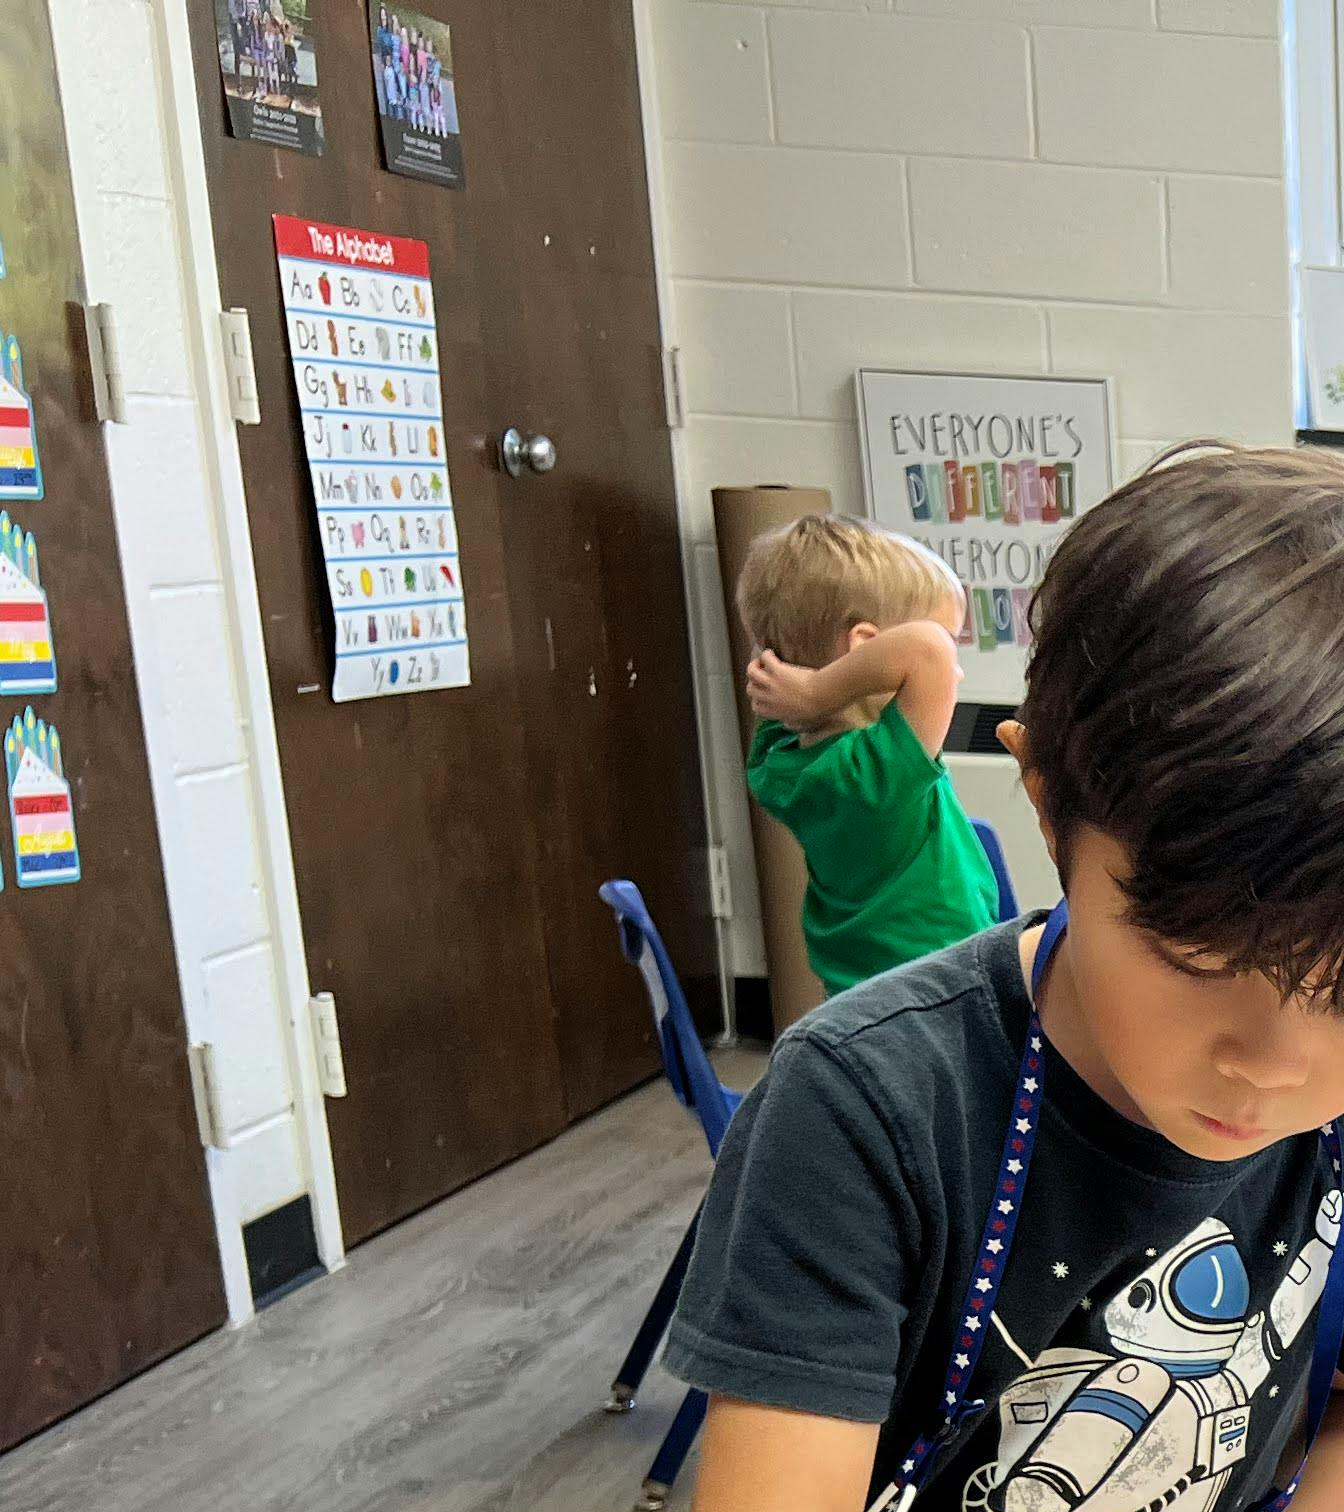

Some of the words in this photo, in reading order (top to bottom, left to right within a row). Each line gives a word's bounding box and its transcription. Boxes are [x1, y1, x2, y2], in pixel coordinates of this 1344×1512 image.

[308, 226, 334, 256] The
[336, 231, 395, 266] Alphabet
[291, 271, 313, 300] Aa
[340, 276, 360, 307] Bb
[296, 320, 318, 351] Dd
[348, 326, 365, 355] Ee
[398, 332, 413, 360] Ff
[304, 365, 329, 408] Gg
[354, 375, 373, 403] Hh
[313, 416, 332, 458] Jj
[360, 424, 377, 452] Kk
[889, 413, 1083, 458] EVERYONE'S
[319, 472, 344, 500] Mm
[365, 473, 383, 501] Nn
[907, 465, 1075, 518] DIFFERENT
[326, 516, 345, 553] Pp
[370, 514, 394, 553] Qq
[416, 517, 430, 544] Rr
[336, 568, 352, 597] Ss
[379, 567, 395, 594] Tt
[342, 619, 358, 646] Vv
[385, 615, 408, 639] Ww
[371, 657, 384, 692] Yy
[407, 656, 422, 684] Zz
